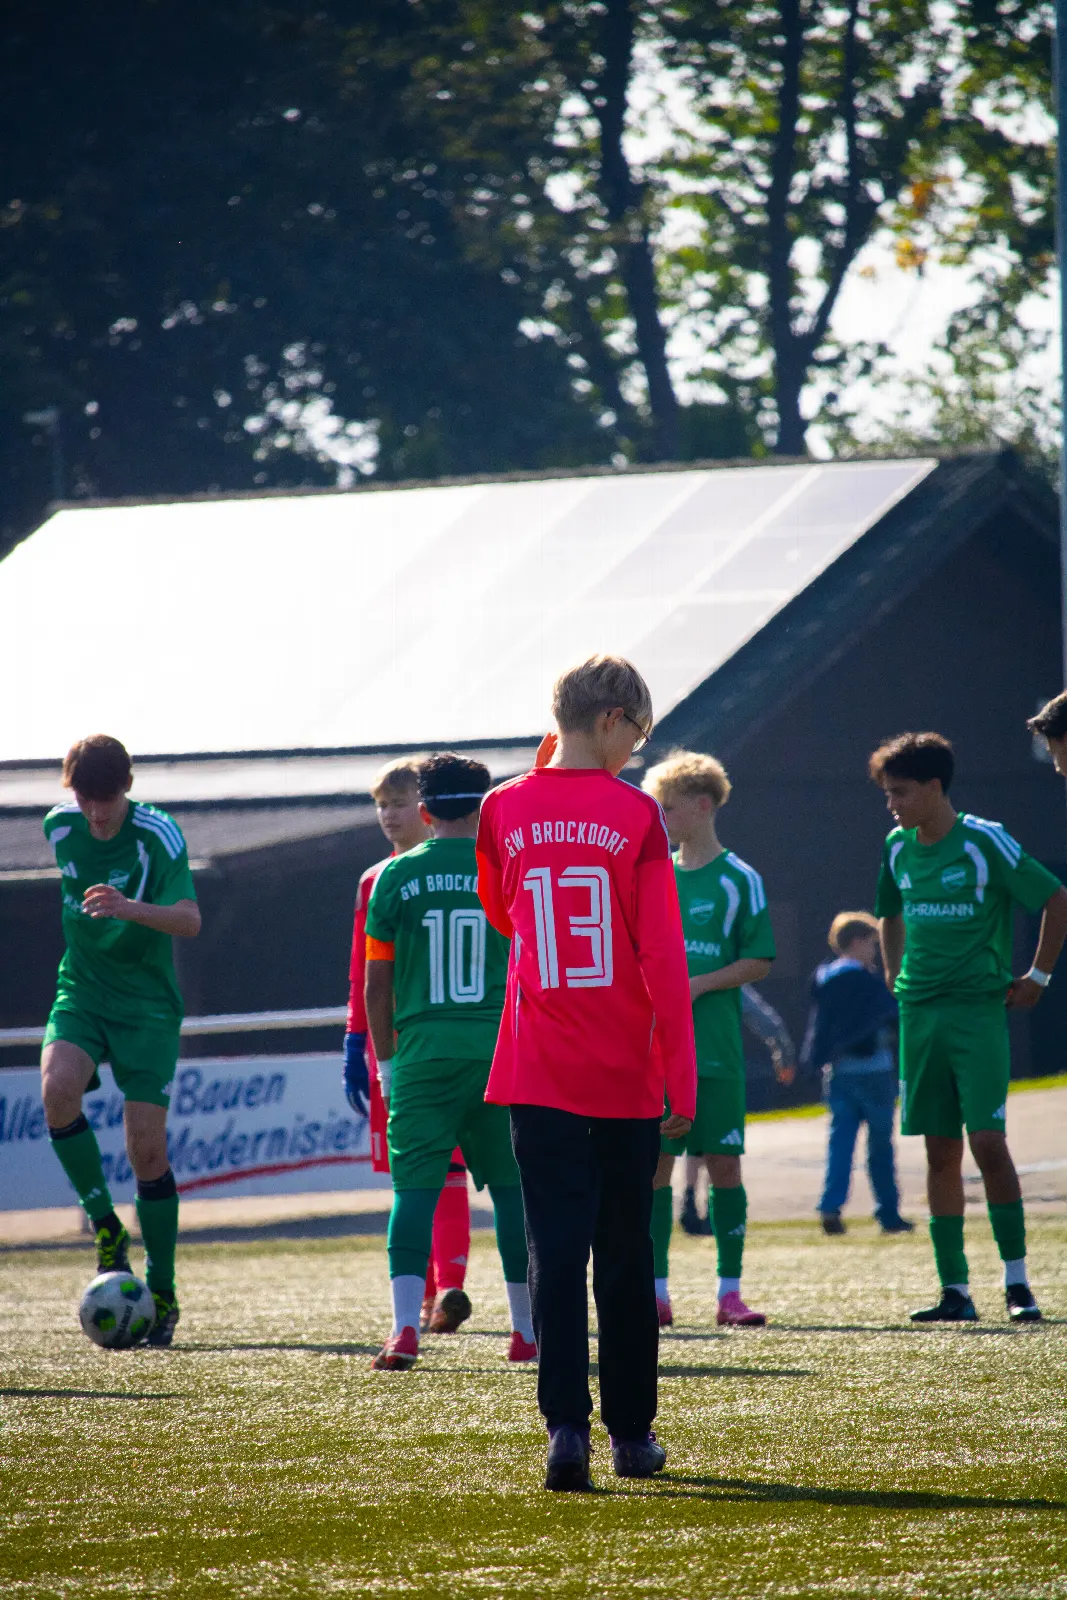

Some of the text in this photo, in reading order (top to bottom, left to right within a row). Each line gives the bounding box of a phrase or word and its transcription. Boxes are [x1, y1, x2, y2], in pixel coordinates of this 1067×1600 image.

[504, 822, 628, 857] GW BROCKDORF
[401, 879, 420, 900] GW
[523, 866, 613, 988] 13
[422, 909, 485, 1003] 10
[684, 939, 721, 957] ANN
[174, 1069, 285, 1117] Bauen
